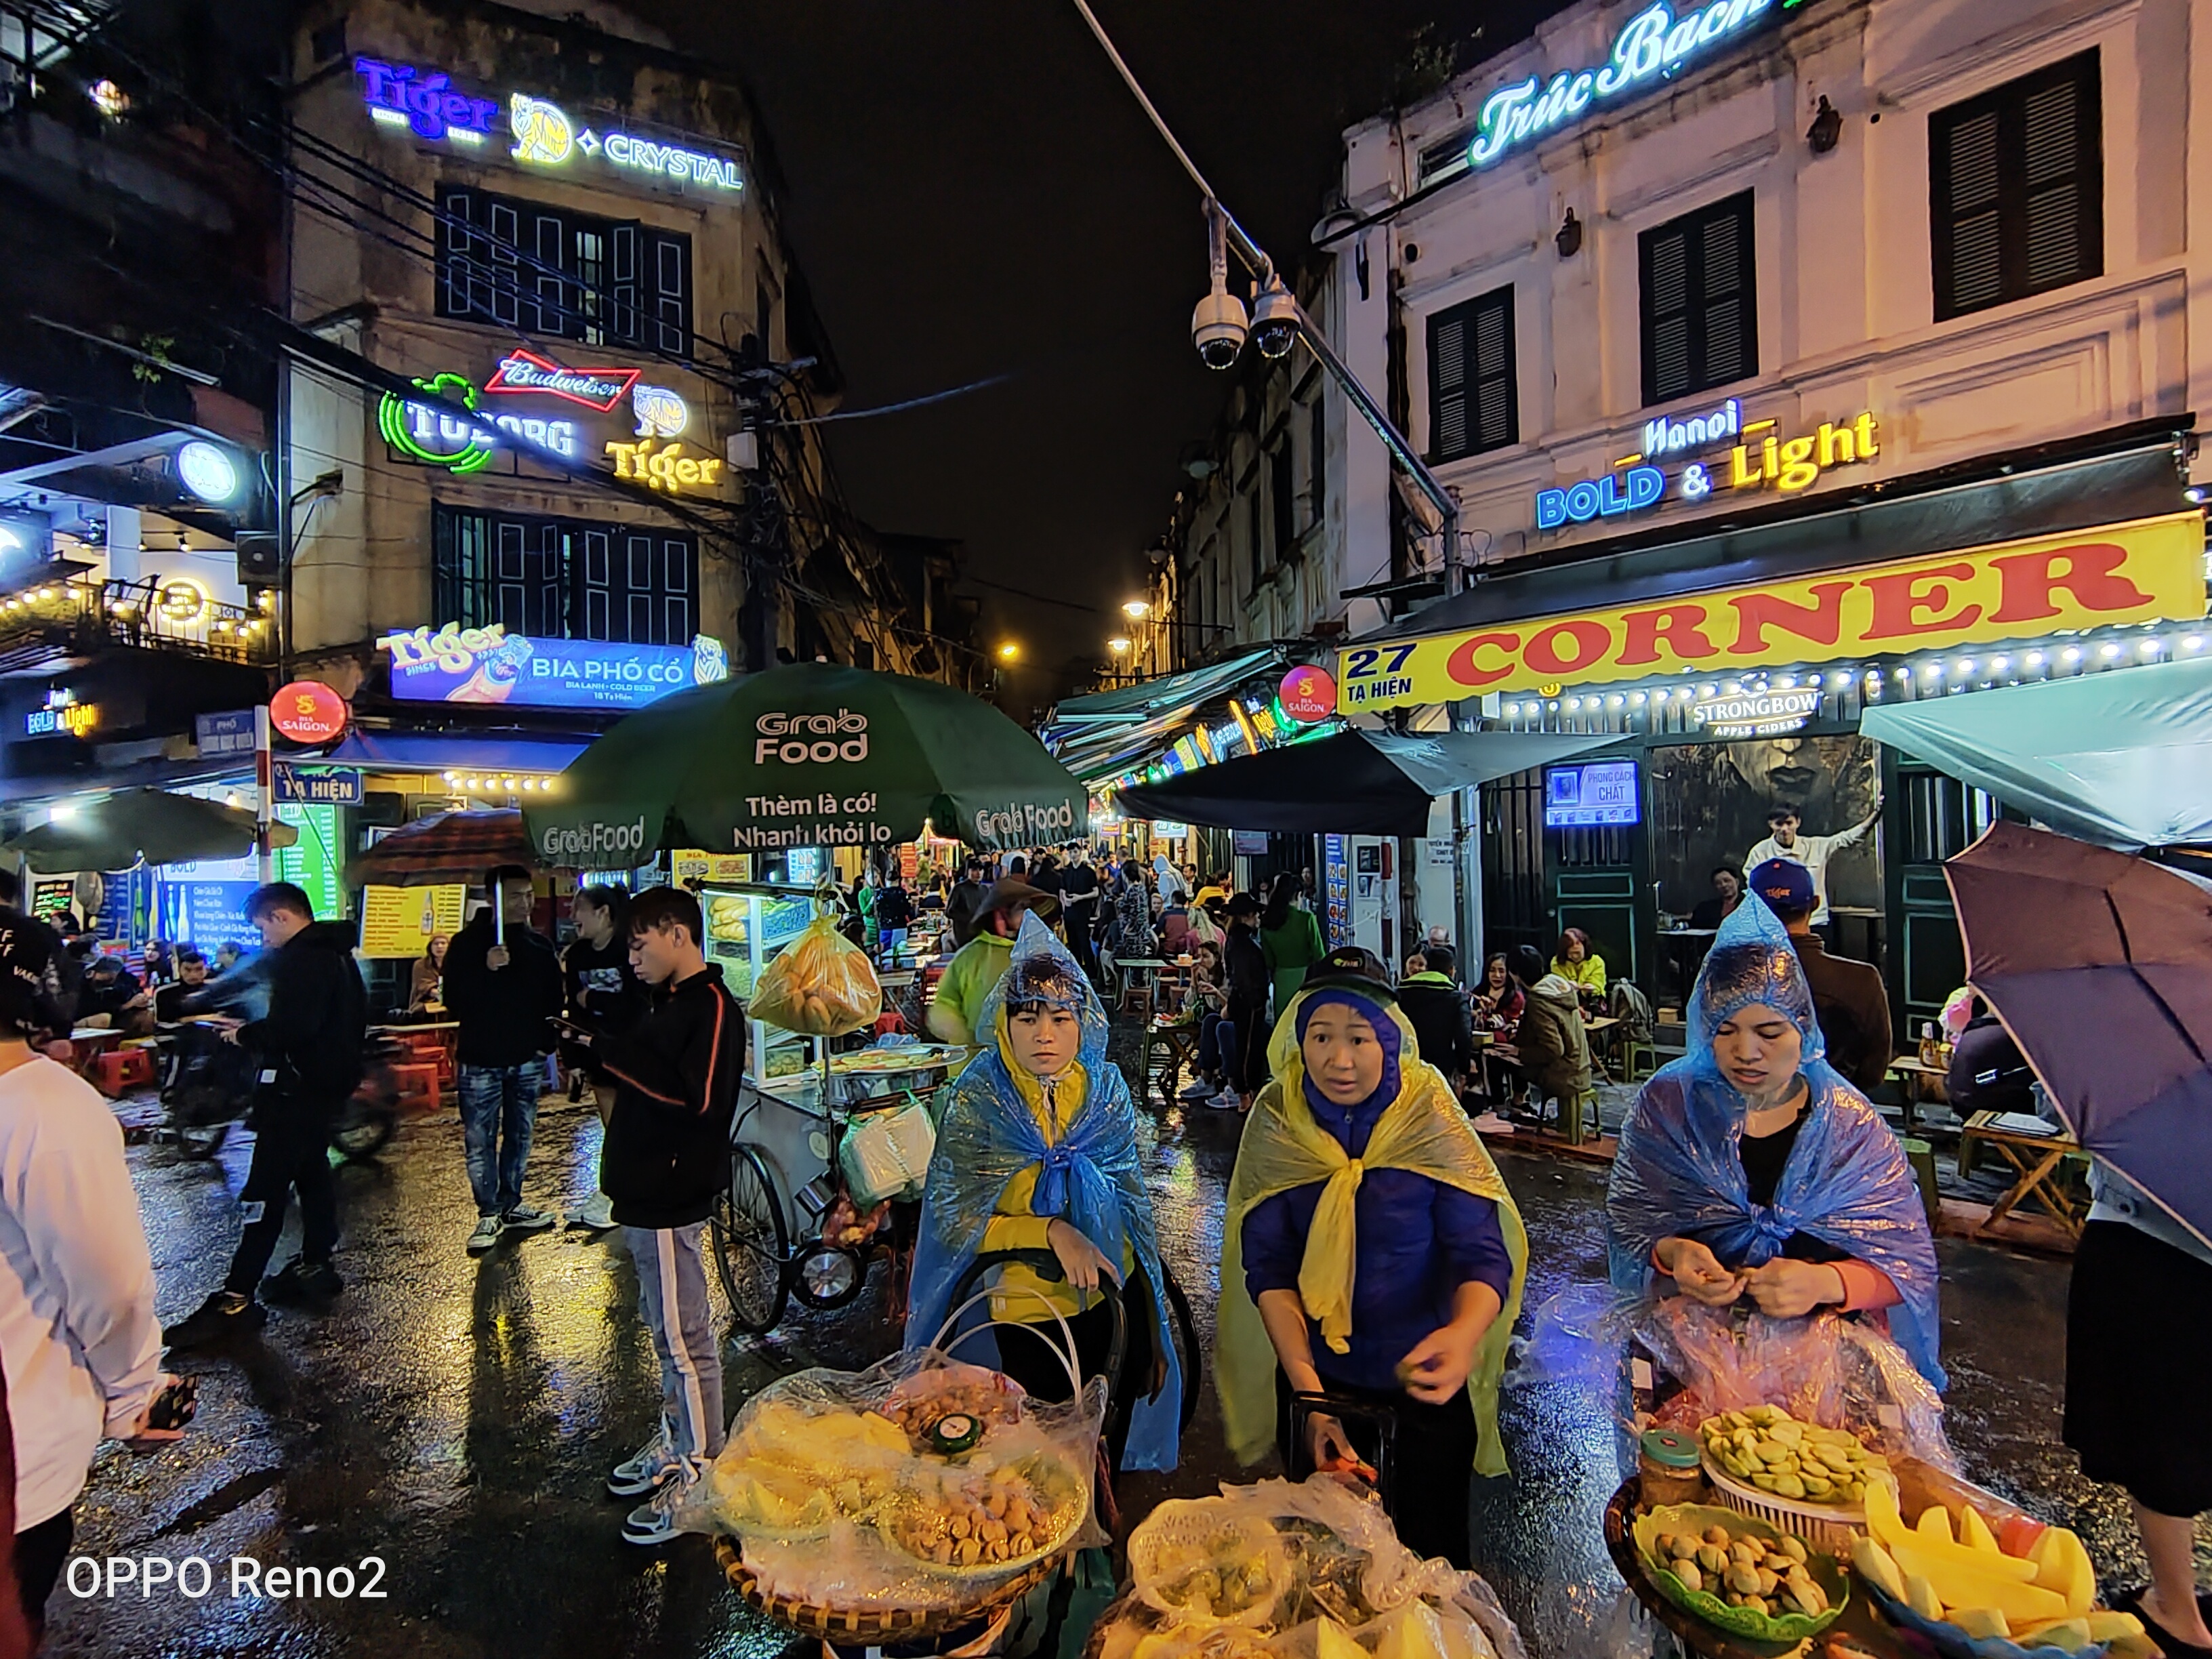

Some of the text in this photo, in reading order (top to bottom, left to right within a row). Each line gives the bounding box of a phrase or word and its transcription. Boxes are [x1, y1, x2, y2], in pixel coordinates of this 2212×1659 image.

[356, 58, 499, 139] Tiger
[1471, 73, 1593, 162] Trúc
[604, 134, 743, 190] CRYSTAL
[498, 357, 623, 397] Budweiser
[407, 401, 573, 457] TUORG
[1643, 398, 1740, 456] Hanoi
[605, 438, 721, 492] Tiger
[1536, 411, 1879, 530] BOLD & Light
[1446, 543, 2156, 686] CORNER
[375, 620, 507, 674] Tiger
[1346, 643, 1418, 680] 27
[531, 656, 684, 683] BIA PHỐ CỔ
[565, 681, 580, 689] BIA
[609, 683, 633, 691] COLD
[1347, 676, 1412, 703] TẠ HIỆN
[756, 708, 868, 735] Grab
[1694, 692, 1819, 723] STRONGBOW
[1714, 717, 1805, 737] APPLE CIDERS
[754, 733, 868, 764] Food
[310, 779, 352, 800] HIỆN
[1588, 772, 1614, 783] PHONG
[1599, 782, 1626, 801] CHẤT
[745, 792, 878, 817] Thèm là có!
[733, 821, 892, 848] Nhanh khỏi lo
